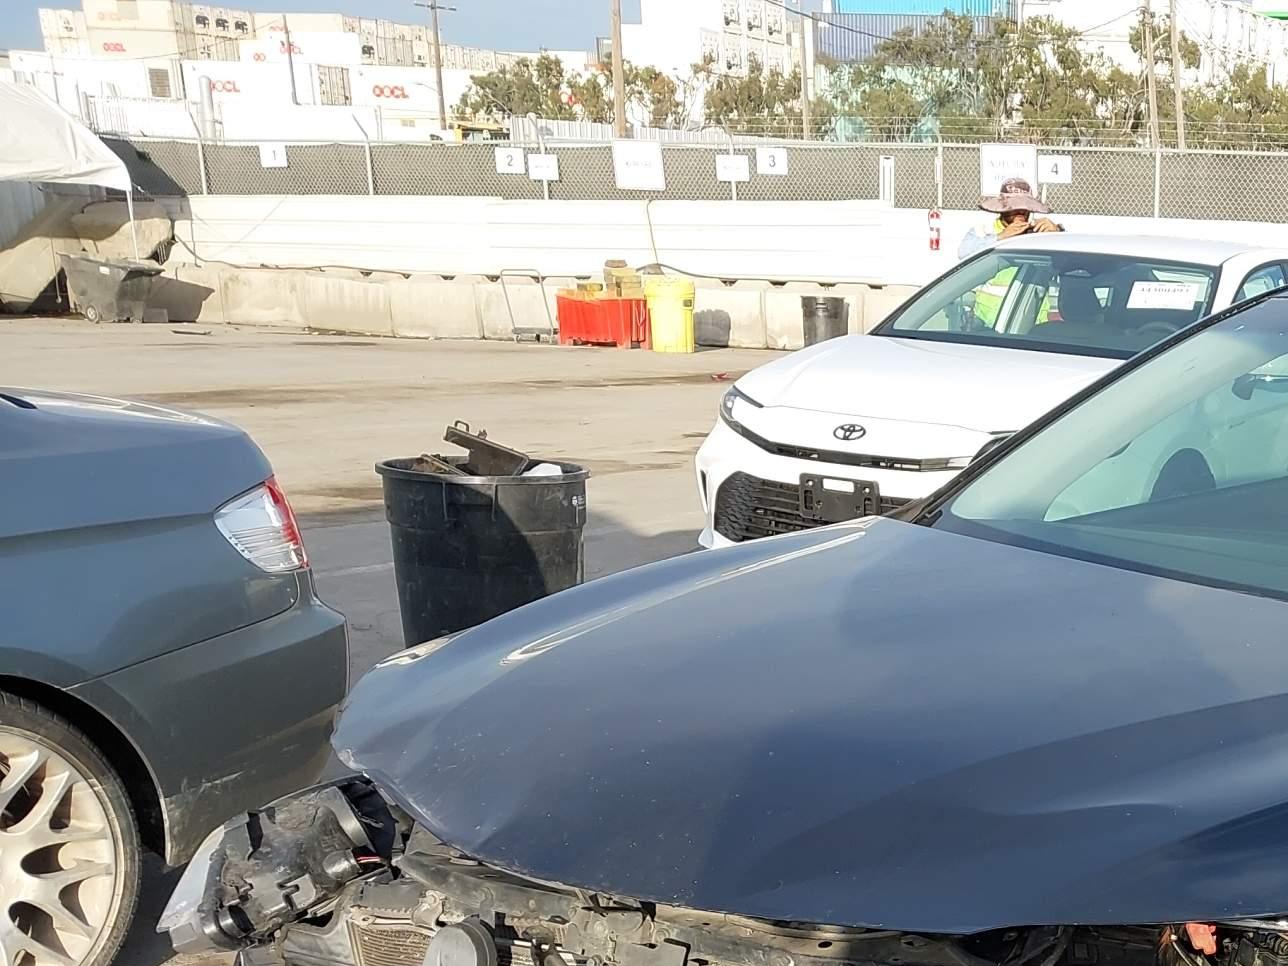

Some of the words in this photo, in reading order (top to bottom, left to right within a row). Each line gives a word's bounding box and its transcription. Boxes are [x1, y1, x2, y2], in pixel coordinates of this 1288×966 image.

[372, 84, 410, 99] OOCL
[506, 154, 514, 167] 2
[768, 155, 777, 168] 3
[1050, 163, 1059, 176] 4
